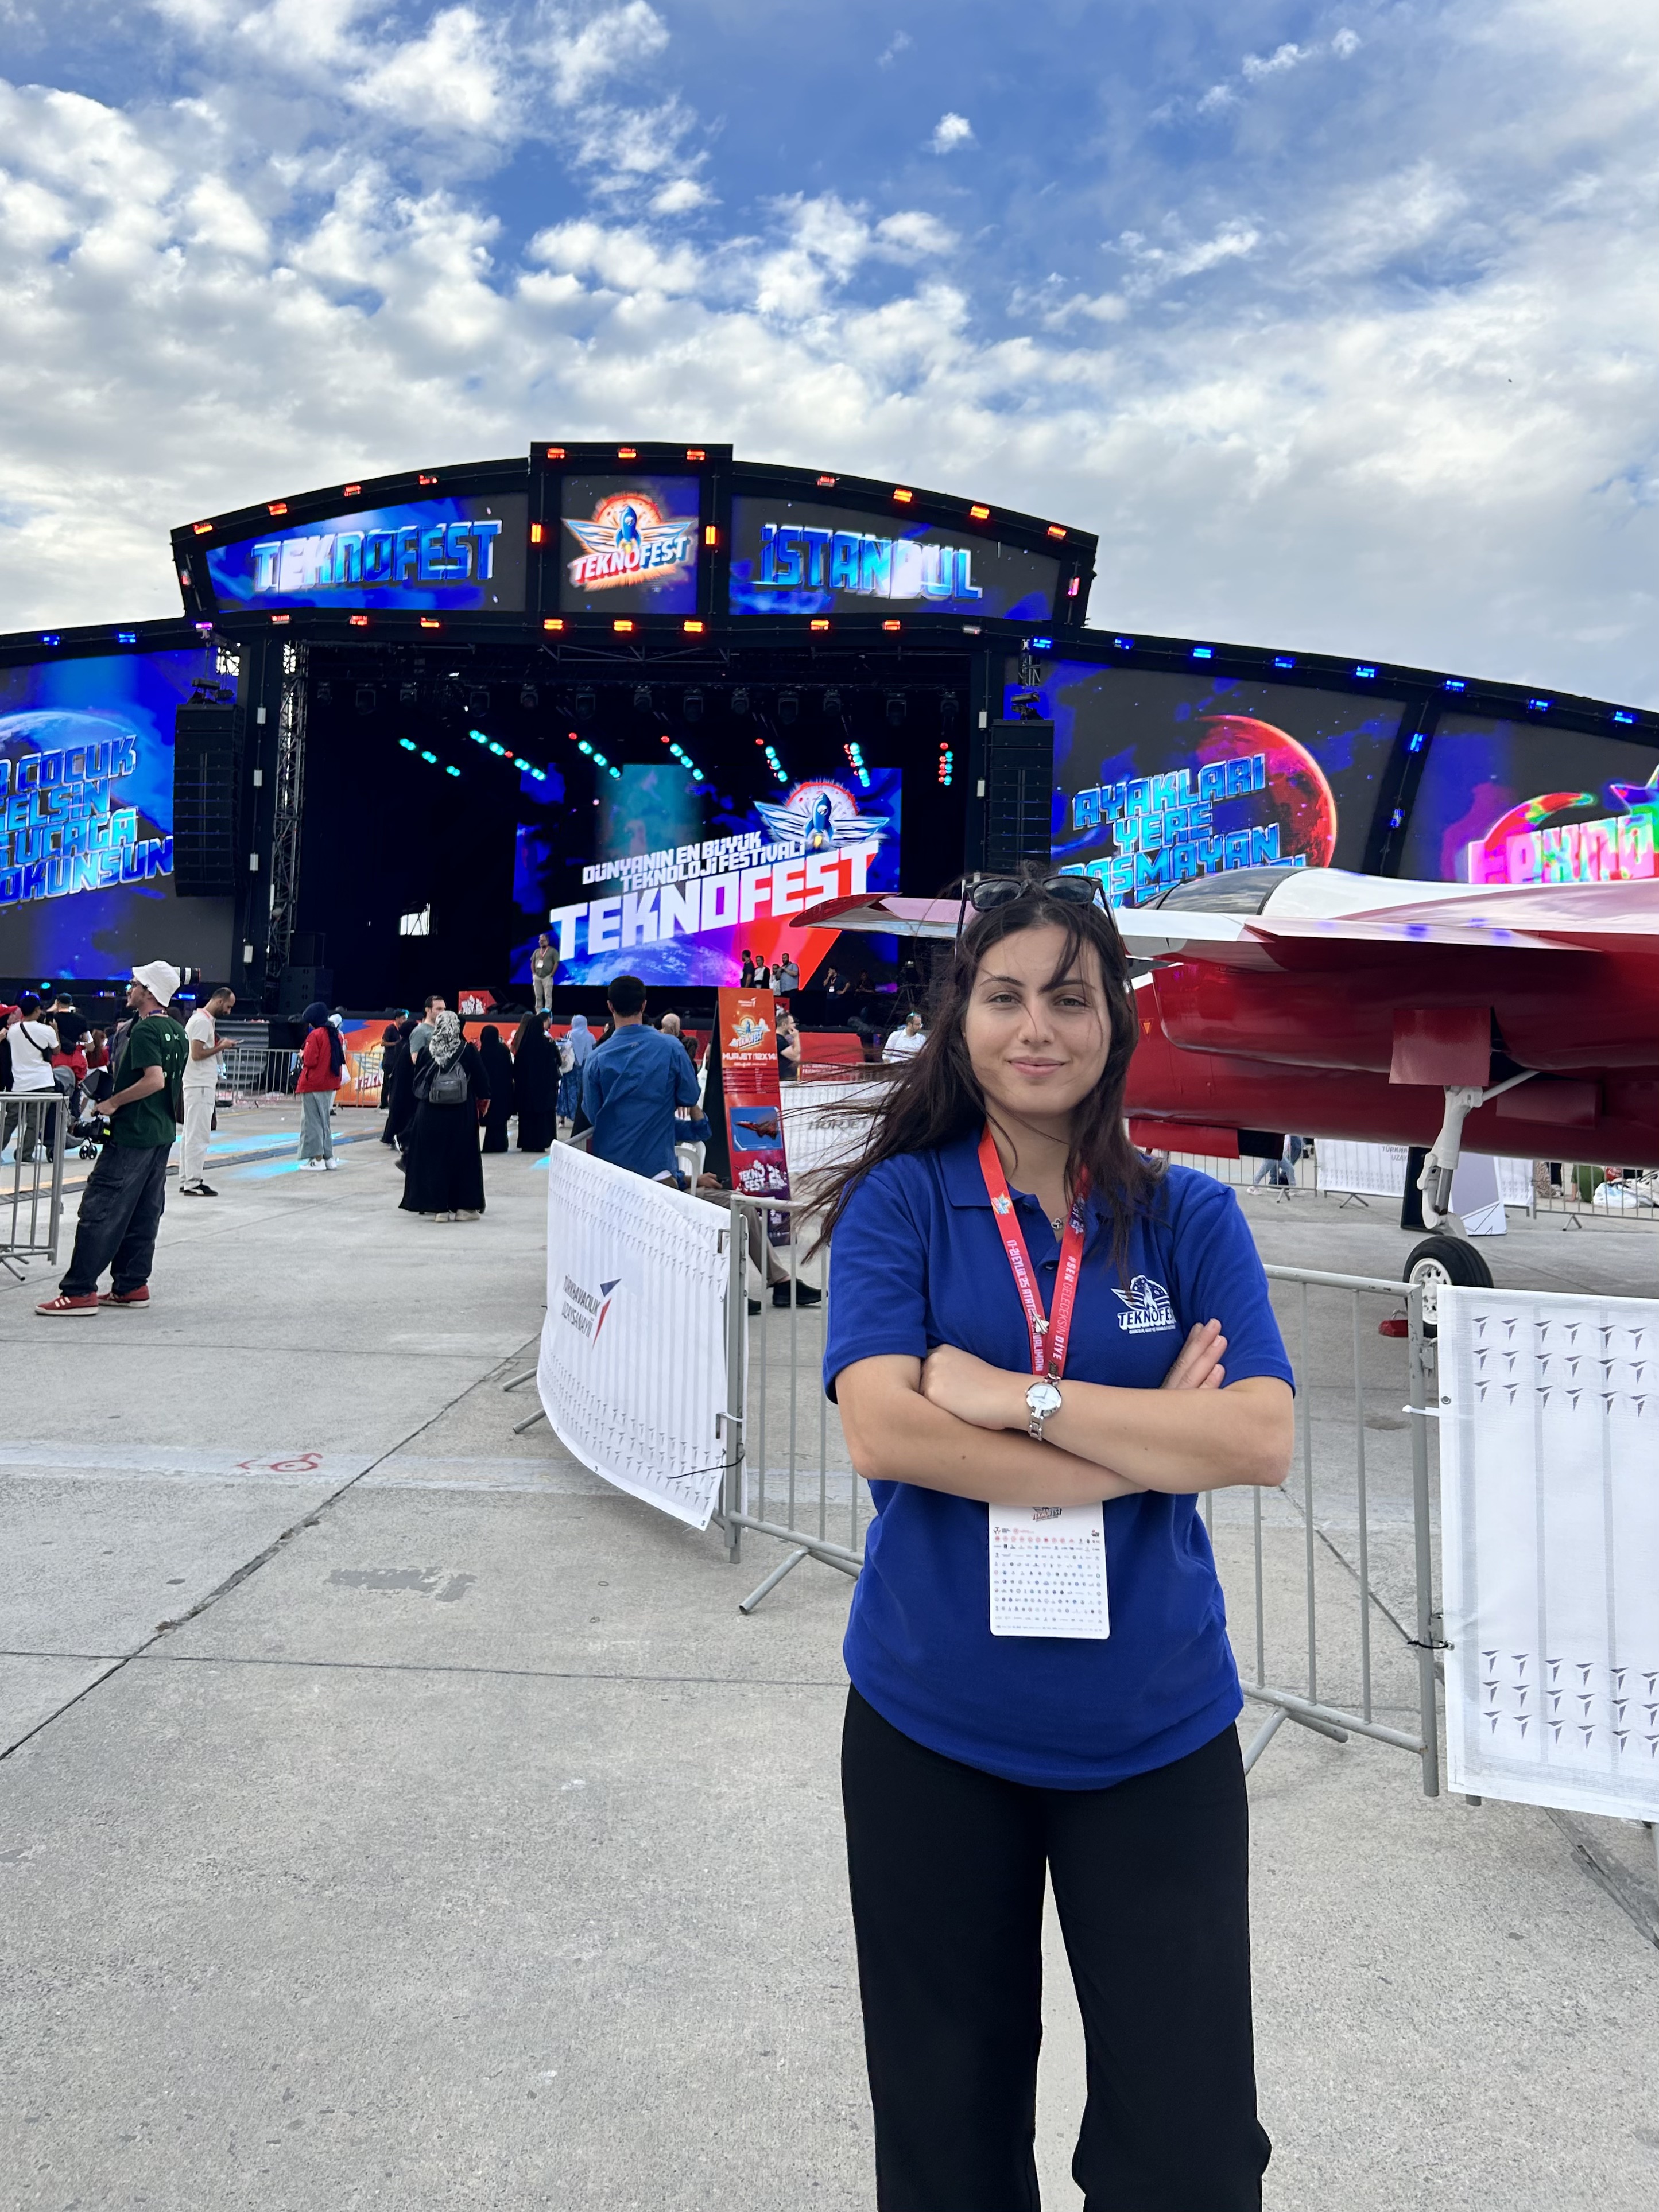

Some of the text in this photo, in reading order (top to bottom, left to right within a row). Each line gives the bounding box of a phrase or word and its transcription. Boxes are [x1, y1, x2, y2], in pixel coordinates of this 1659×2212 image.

[251, 519, 503, 592] TEKNOFEST
[574, 536, 691, 583] TEKNOFEST
[0, 778, 111, 833] ELSİN
[1073, 753, 1265, 830] AYAKLARI
[1113, 803, 1214, 855] YERE
[0, 836, 174, 907] OKUNSUN
[582, 831, 762, 884] DÜNYANIN EN BÜYÜK
[620, 839, 806, 893] TEKNOLOJİ FESTİVALİ
[1059, 823, 1280, 894] ASMAYAN
[549, 840, 879, 962] TEKNOFEST
[1064, 1255, 1077, 1282] #SEN
[1117, 1306, 1176, 1330] TEKNOFE
[1052, 1334, 1065, 1360] DİYE
